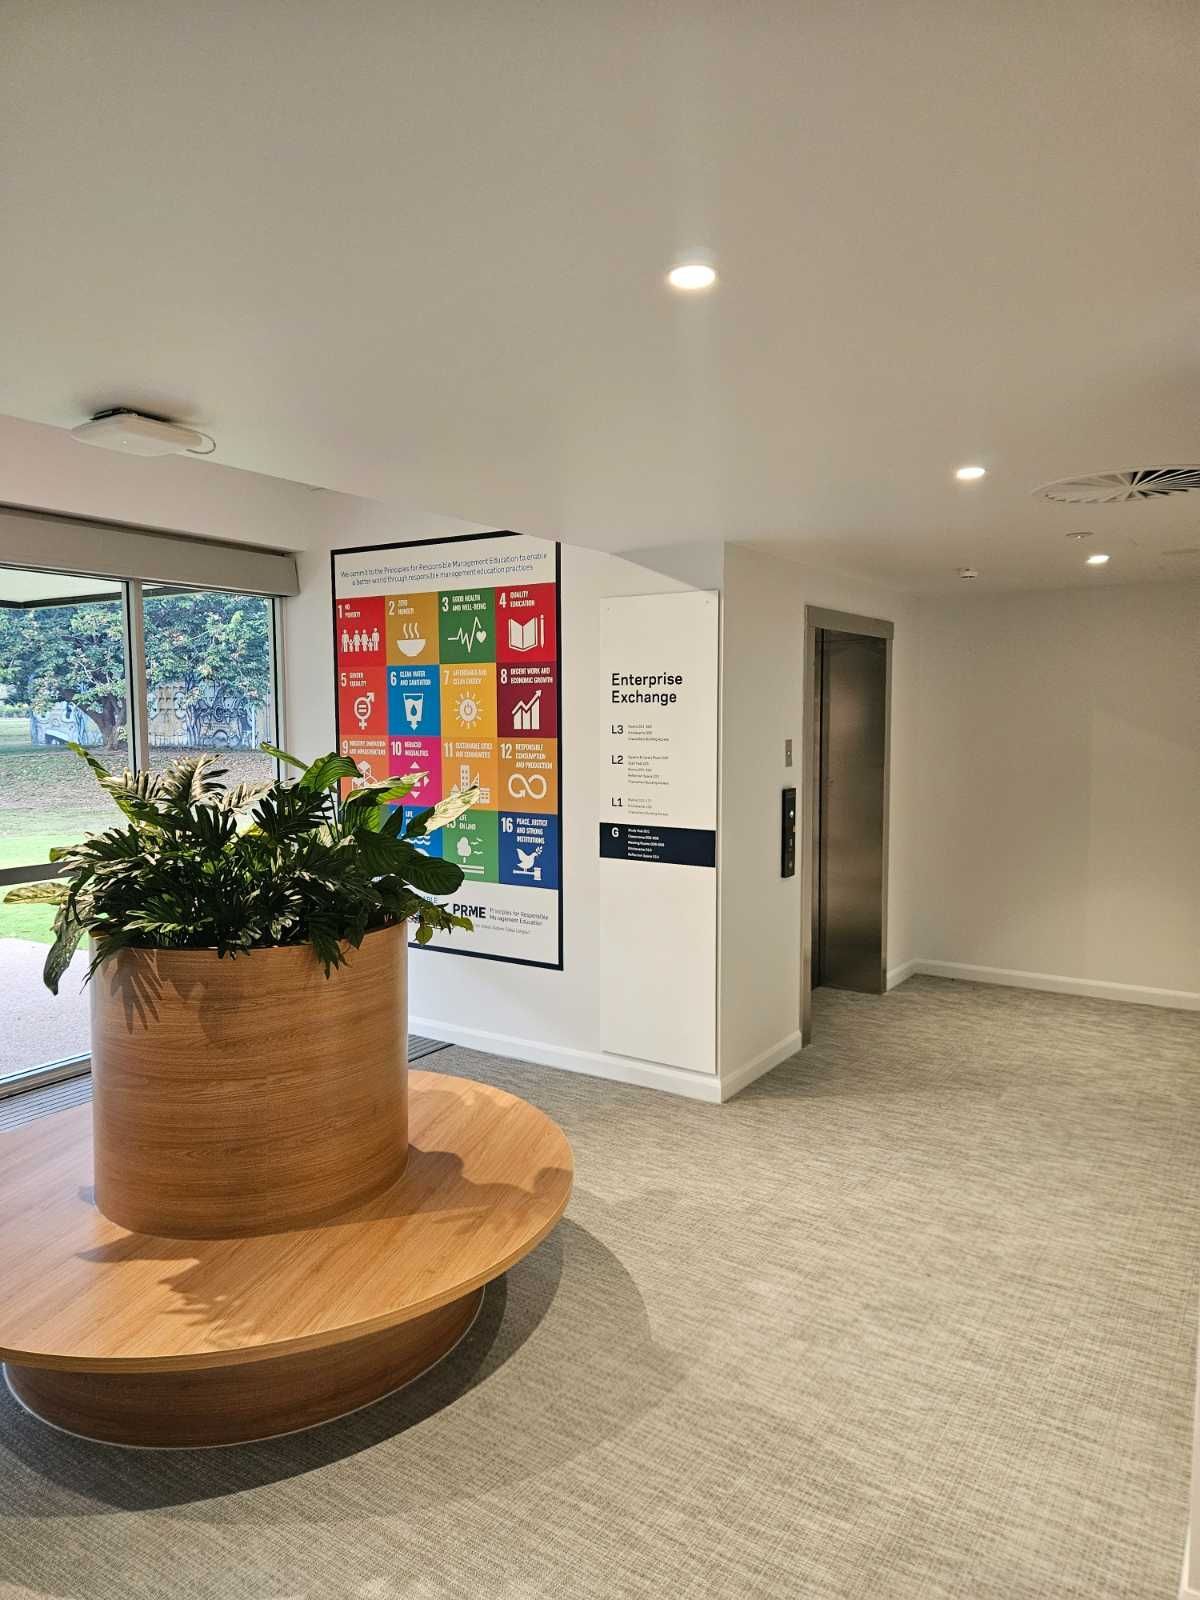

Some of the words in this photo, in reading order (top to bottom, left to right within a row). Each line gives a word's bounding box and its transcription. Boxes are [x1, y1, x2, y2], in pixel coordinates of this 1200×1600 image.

[452, 558, 488, 568] Management
[489, 555, 518, 564] Education
[476, 566, 504, 576] education
[505, 564, 534, 574] practices
[464, 594, 480, 602] HEALTH
[499, 592, 507, 608] 4
[510, 590, 528, 599] QUALITY
[388, 600, 395, 616] 2
[442, 596, 449, 612] 3
[462, 602, 486, 611] WELL-BEING
[510, 599, 535, 608] EDUCATION
[338, 604, 342, 619] 1
[341, 672, 347, 688] 5
[390, 672, 397, 687] 6
[444, 670, 450, 686] 7
[500, 668, 508, 684] 8
[612, 672, 682, 688] Enterprise
[612, 690, 677, 706] Exchange
[611, 724, 624, 735] L3
[342, 740, 348, 754] 9
[390, 741, 402, 756] 10
[444, 742, 453, 758] 11
[500, 743, 512, 759] 12
[611, 754, 624, 765] L2
[611, 796, 623, 807] L1
[501, 816, 514, 833] 16
[526, 828, 544, 836] STRONG
[611, 827, 620, 838] G
[452, 904, 486, 918] PRME
